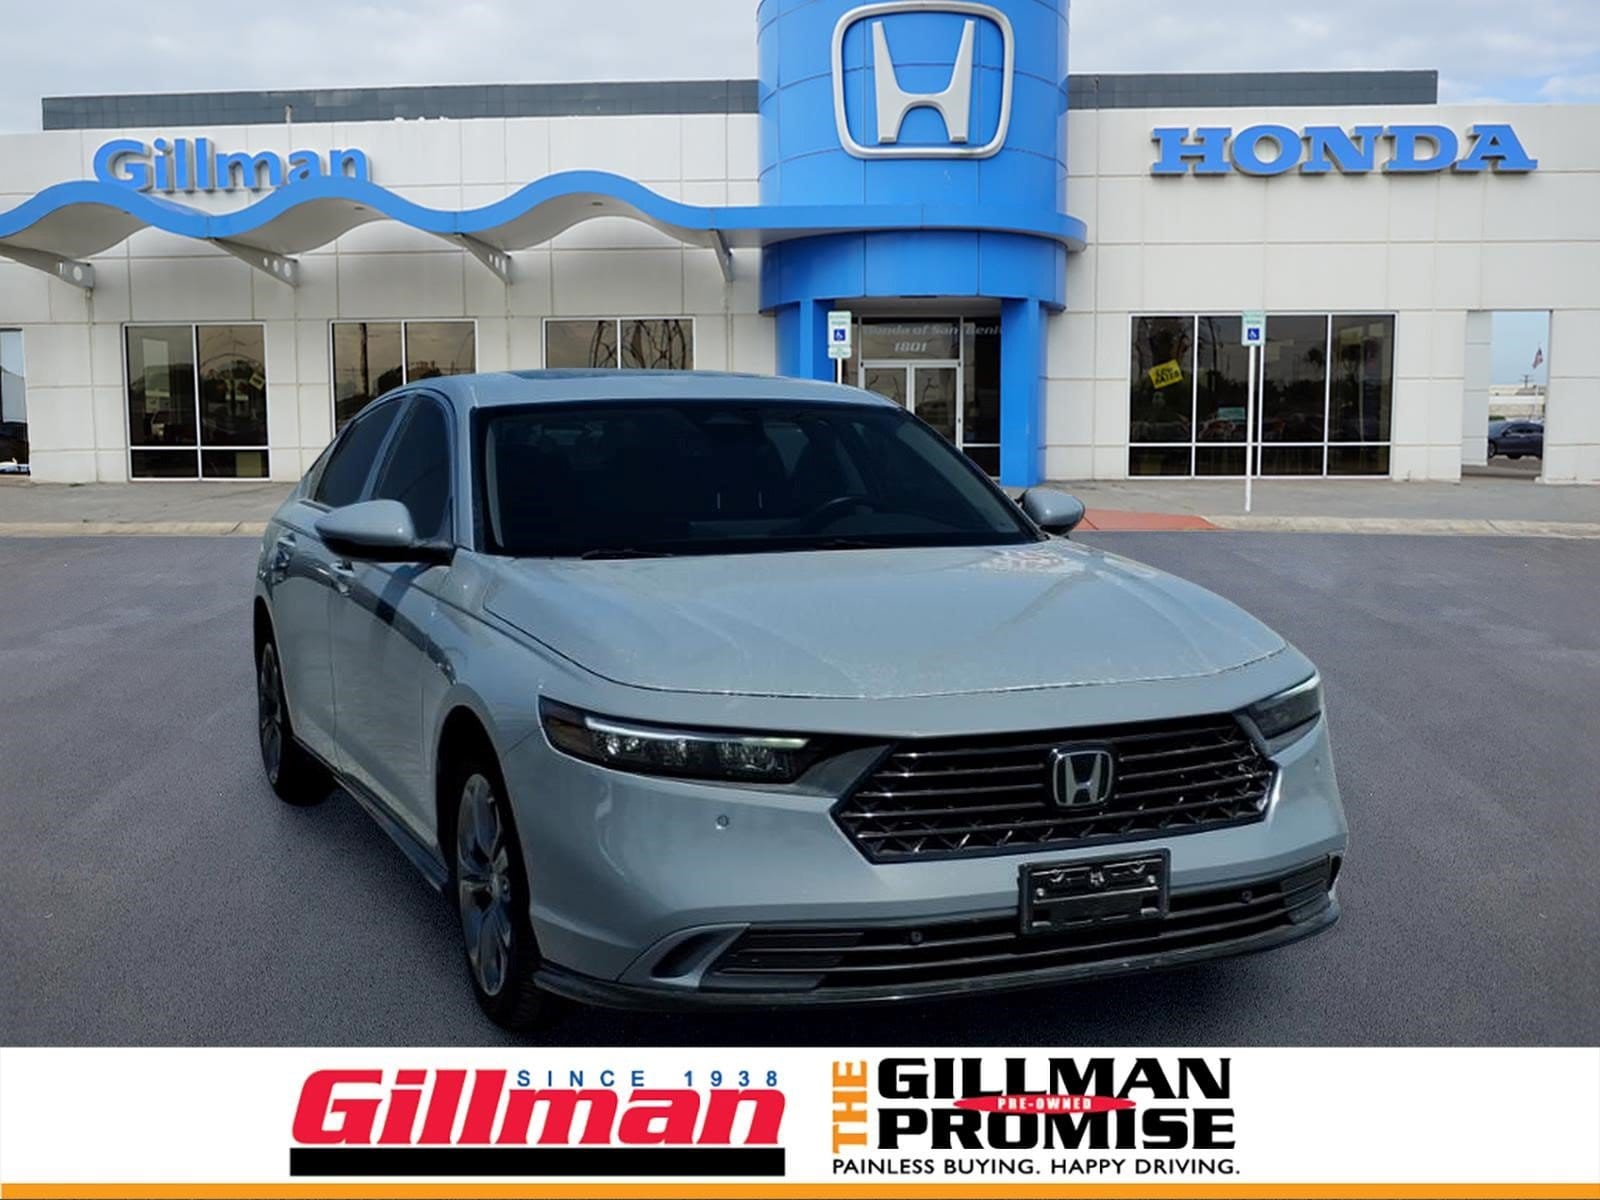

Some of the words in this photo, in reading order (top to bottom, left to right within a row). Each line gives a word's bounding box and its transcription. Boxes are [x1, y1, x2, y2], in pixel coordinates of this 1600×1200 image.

[93, 137, 369, 190] Gillman
[1151, 124, 1538, 176] HONDA
[894, 342, 928, 352] 1801
